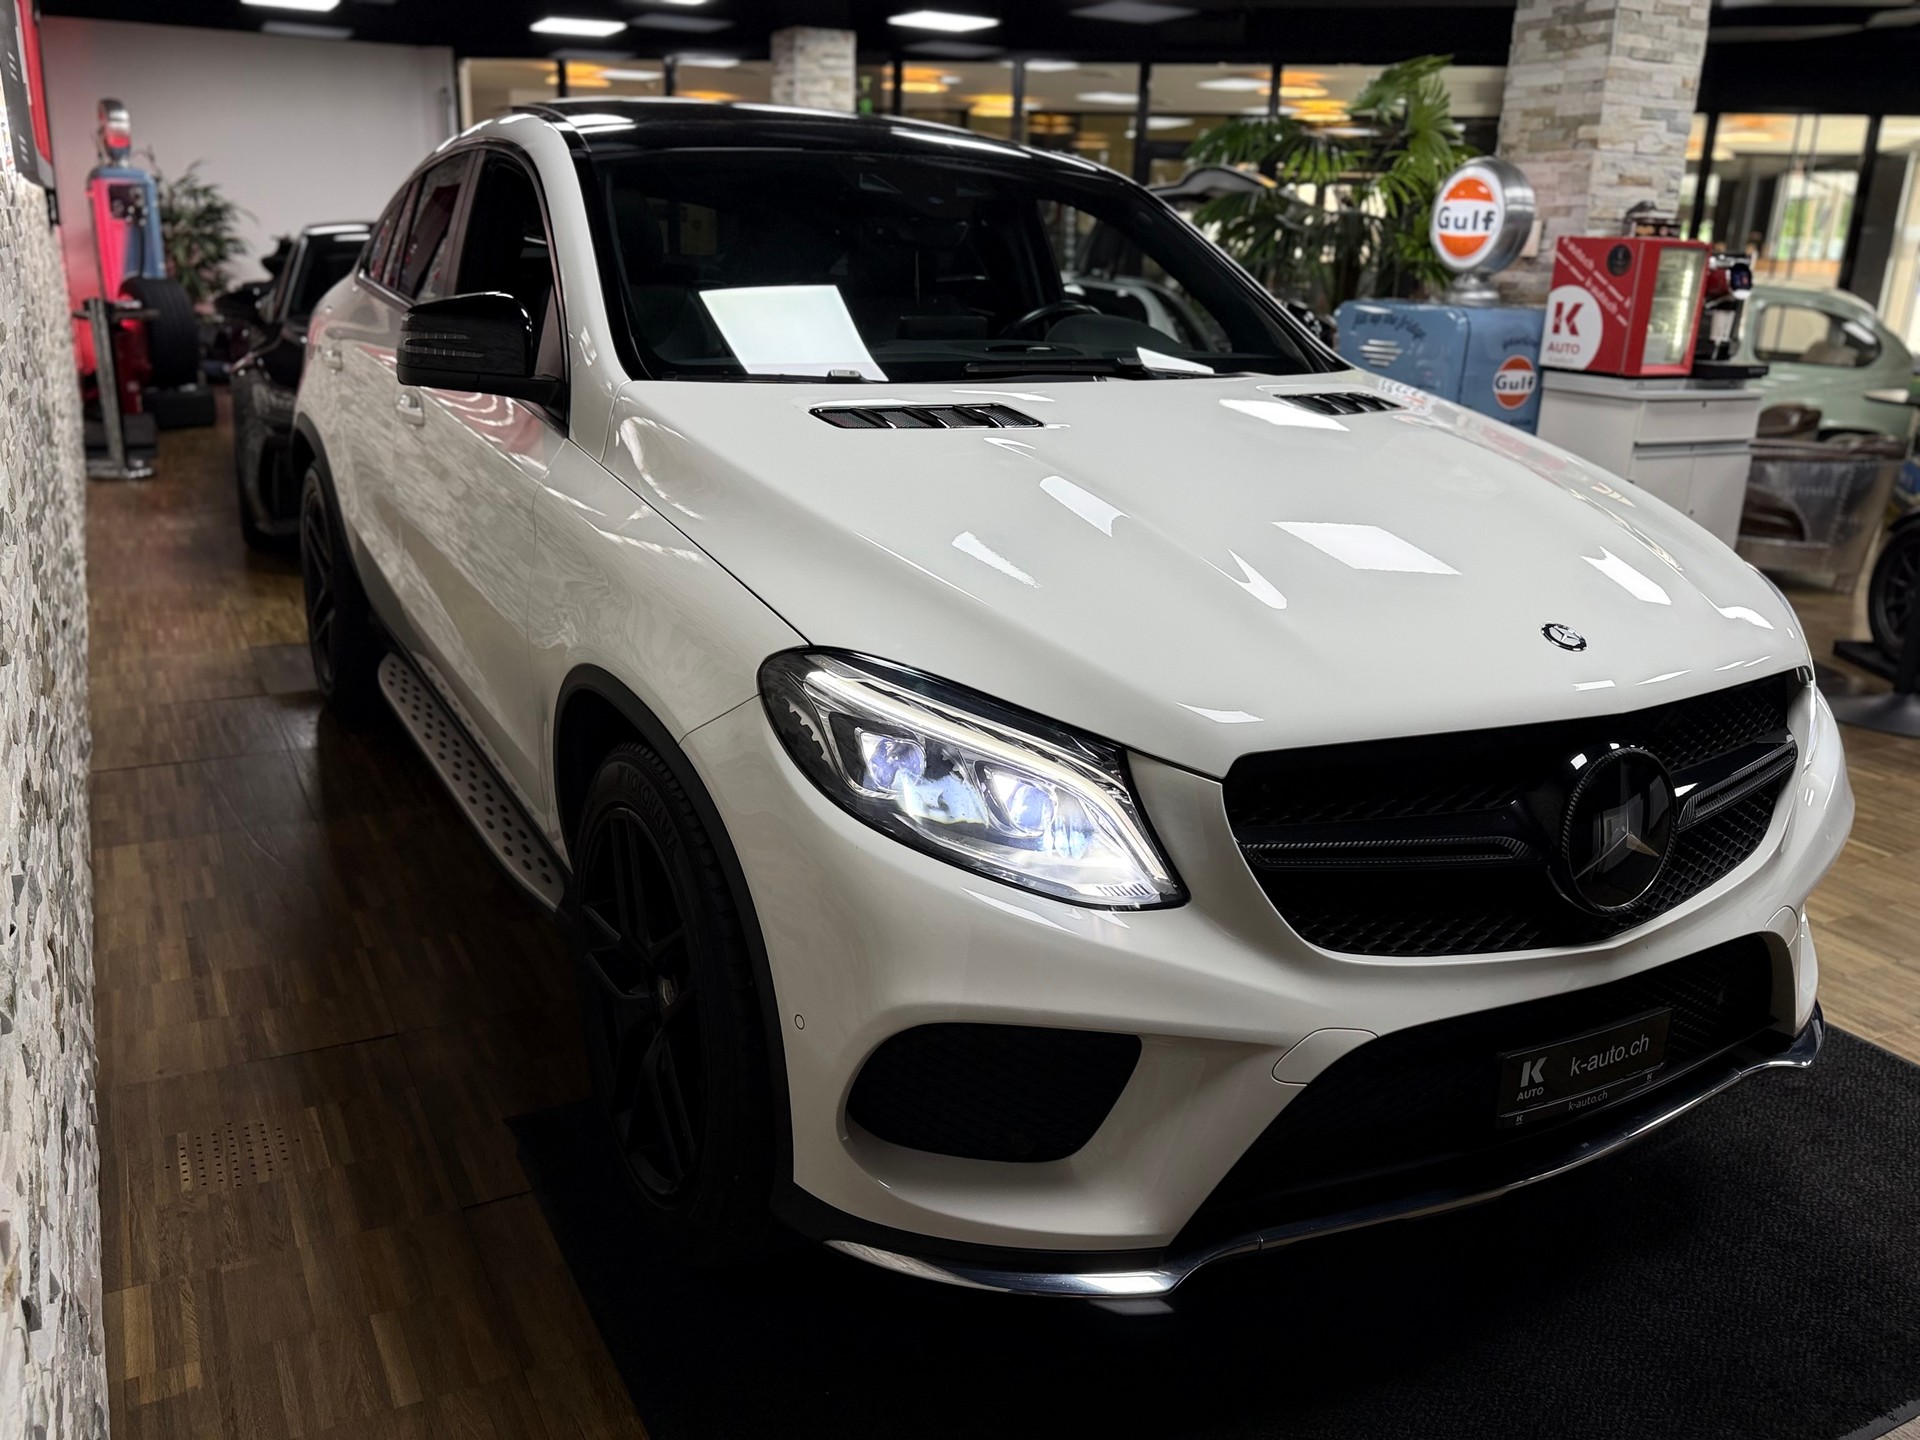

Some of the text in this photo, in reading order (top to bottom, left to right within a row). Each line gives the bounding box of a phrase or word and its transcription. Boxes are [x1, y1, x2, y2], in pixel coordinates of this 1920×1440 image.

[1438, 206, 1496, 233] Gulf
[1552, 302, 1583, 336] K
[1547, 342, 1580, 355] AUTO
[1495, 370, 1536, 391] Gulf
[1570, 1033, 1649, 1076] k-auto.ch
[1520, 1057, 1547, 1087] K
[1516, 1087, 1544, 1101] AUTO
[1568, 1090, 1607, 1111] k-auto.ch
